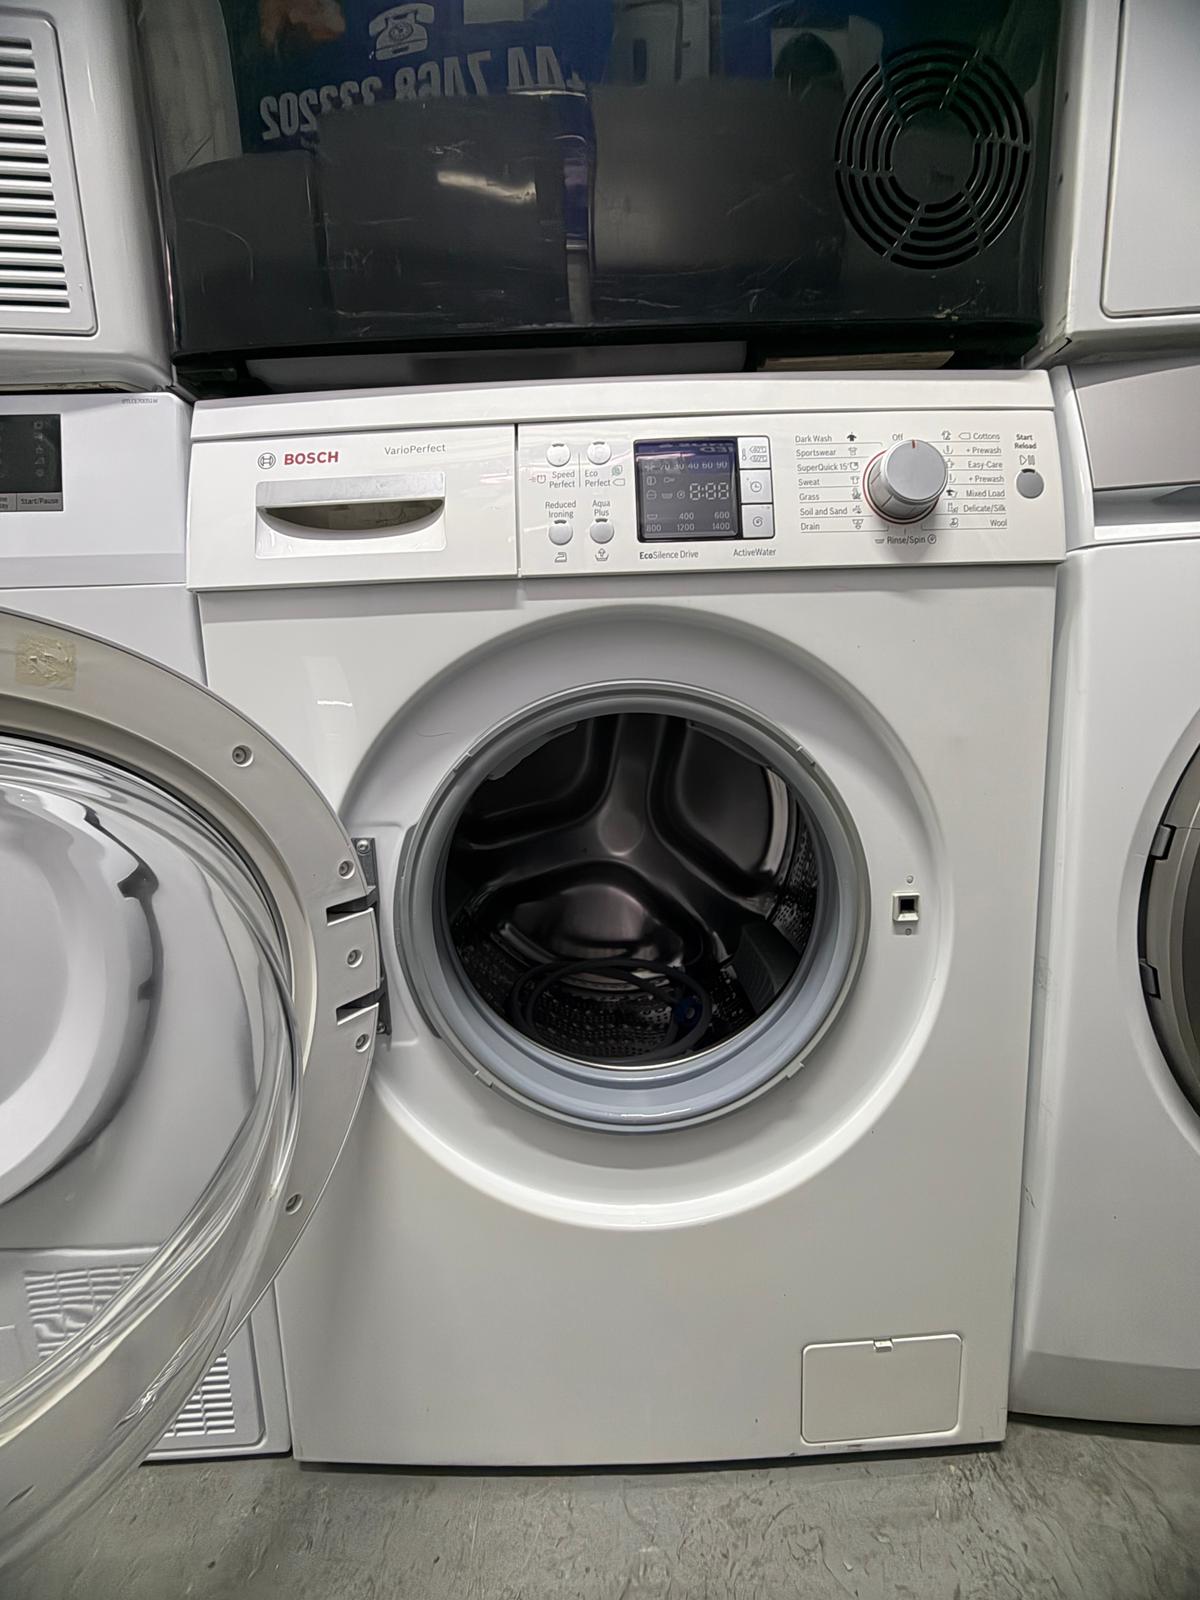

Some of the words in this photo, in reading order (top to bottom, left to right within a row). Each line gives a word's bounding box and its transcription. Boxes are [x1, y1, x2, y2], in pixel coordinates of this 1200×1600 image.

[795, 435, 812, 443] Dark
[812, 434, 833, 443] Wash
[892, 433, 904, 441] Off
[973, 432, 1001, 440] Cottons
[1015, 433, 1034, 441] Start
[384, 443, 447, 456] VarioPerfect
[972, 446, 1002, 454] Prewash
[1014, 442, 1038, 450] Reload
[796, 448, 836, 458] Sportswear
[284, 451, 340, 466] BOSCH
[797, 463, 838, 473] SuperQuick
[552, 470, 576, 479] Speed
[584, 469, 599, 477] Eco
[549, 480, 576, 489] Perfect
[584, 479, 611, 487] Perfect
[798, 478, 820, 486] Sweat
[799, 493, 820, 501] Grass
[966, 489, 987, 497] Mixed
[988, 489, 1006, 497] Load
[545, 500, 577, 509] Reduced
[592, 500, 611, 508] Aqua
[963, 504, 1007, 513] Delicate/Silk
[548, 510, 574, 519] Ironing
[594, 508, 610, 517] Plus
[679, 511, 695, 520] 400
[714, 511, 730, 520] 600
[800, 507, 814, 516] Soil
[815, 507, 828, 515] and
[829, 506, 848, 515] Sand
[677, 522, 695, 531] 1200
[712, 522, 730, 531] 1400
[800, 522, 820, 530] Drain
[990, 519, 1008, 527] Wool
[886, 535, 926, 545] Rinse/Spin
[639, 550, 679, 560] EcoSilence
[680, 549, 699, 559] Drive
[733, 547, 777, 557] ActiveWater
